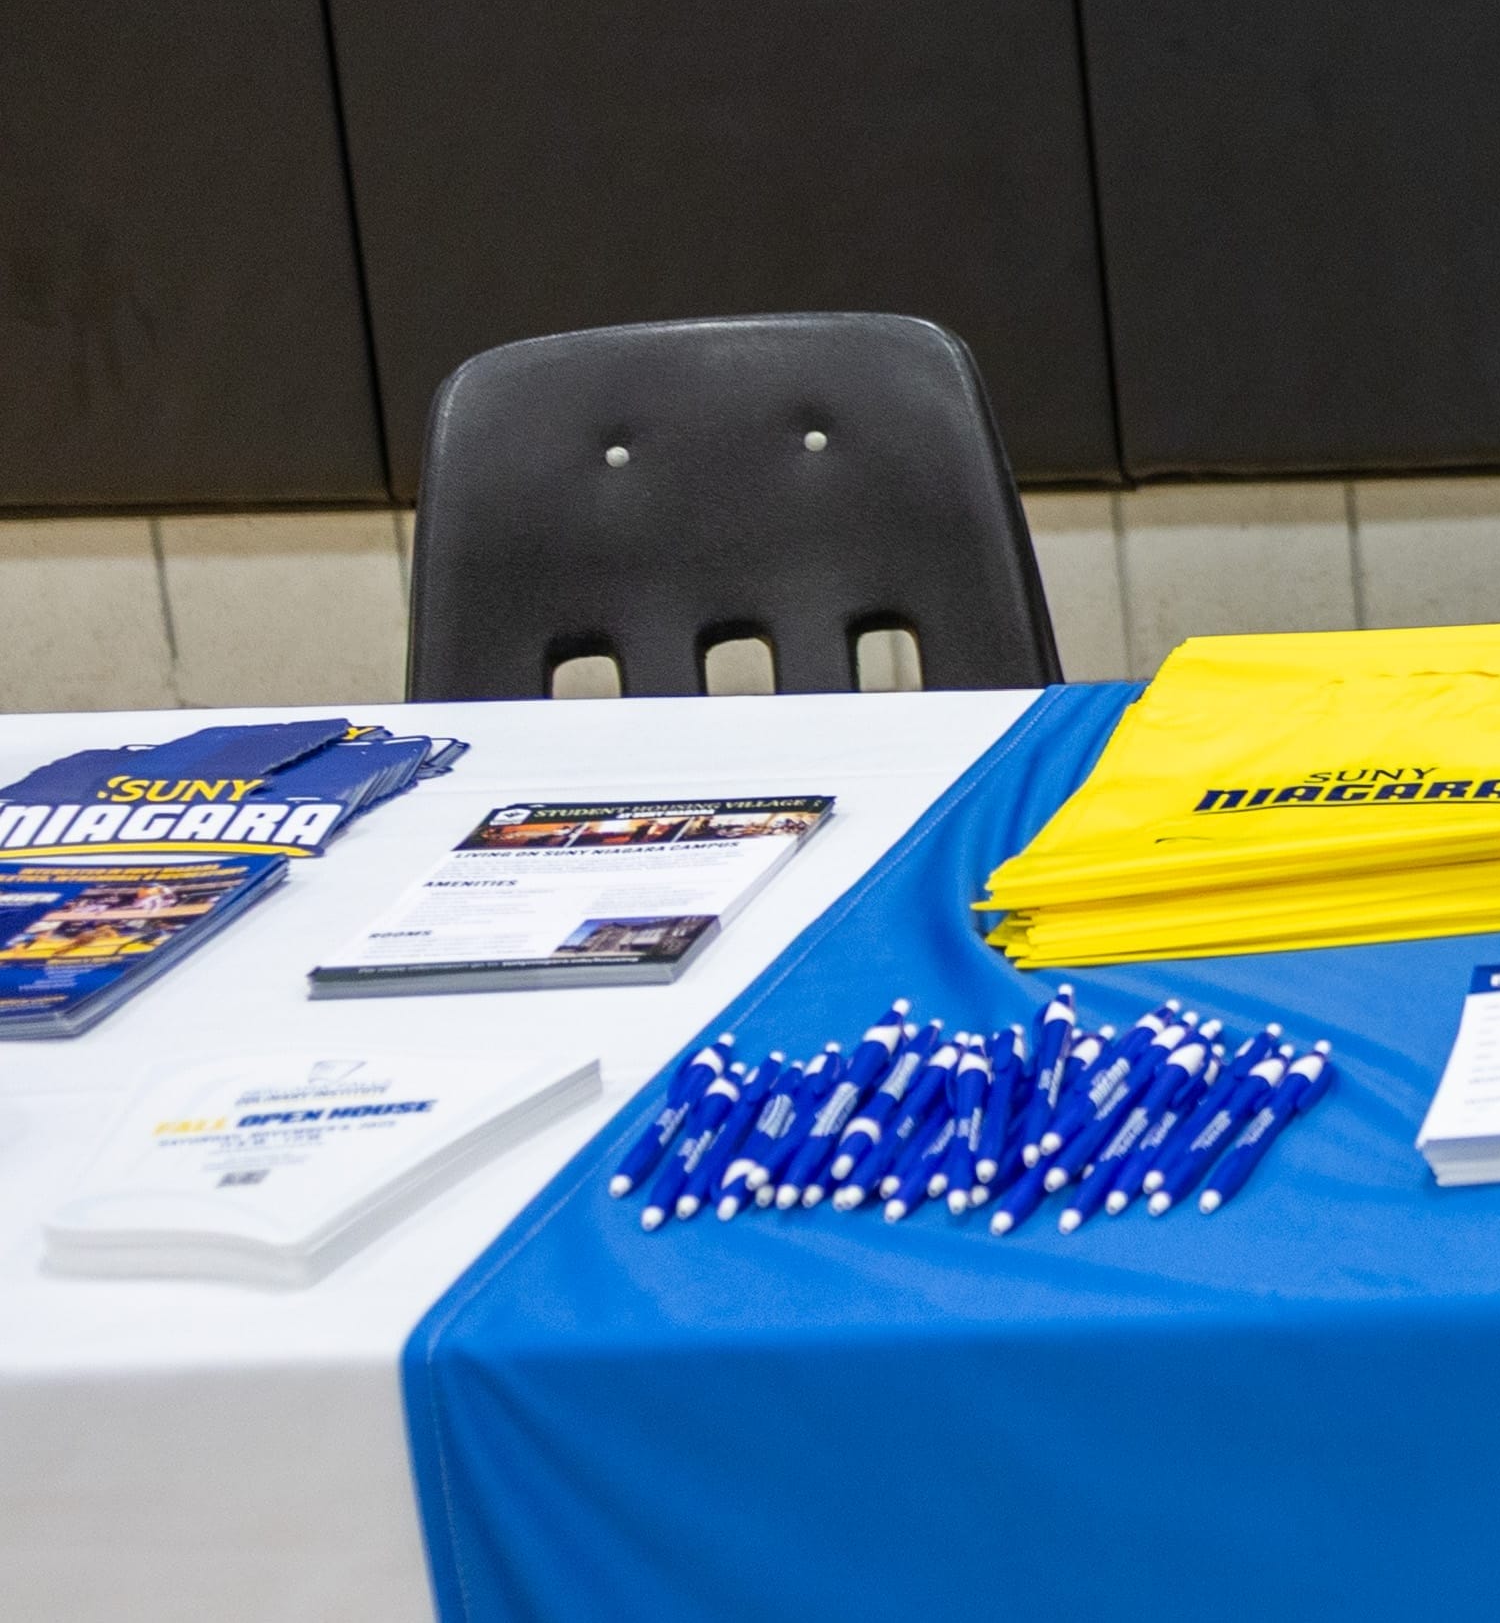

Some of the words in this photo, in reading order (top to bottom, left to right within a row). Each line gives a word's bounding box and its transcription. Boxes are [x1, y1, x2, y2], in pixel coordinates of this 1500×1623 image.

[1308, 766, 1437, 785] SUNY
[112, 778, 262, 802] SUNY
[533, 806, 622, 819] STUDENT
[725, 798, 806, 810] VILLAGE
[4, 803, 344, 848] NIAGARA
